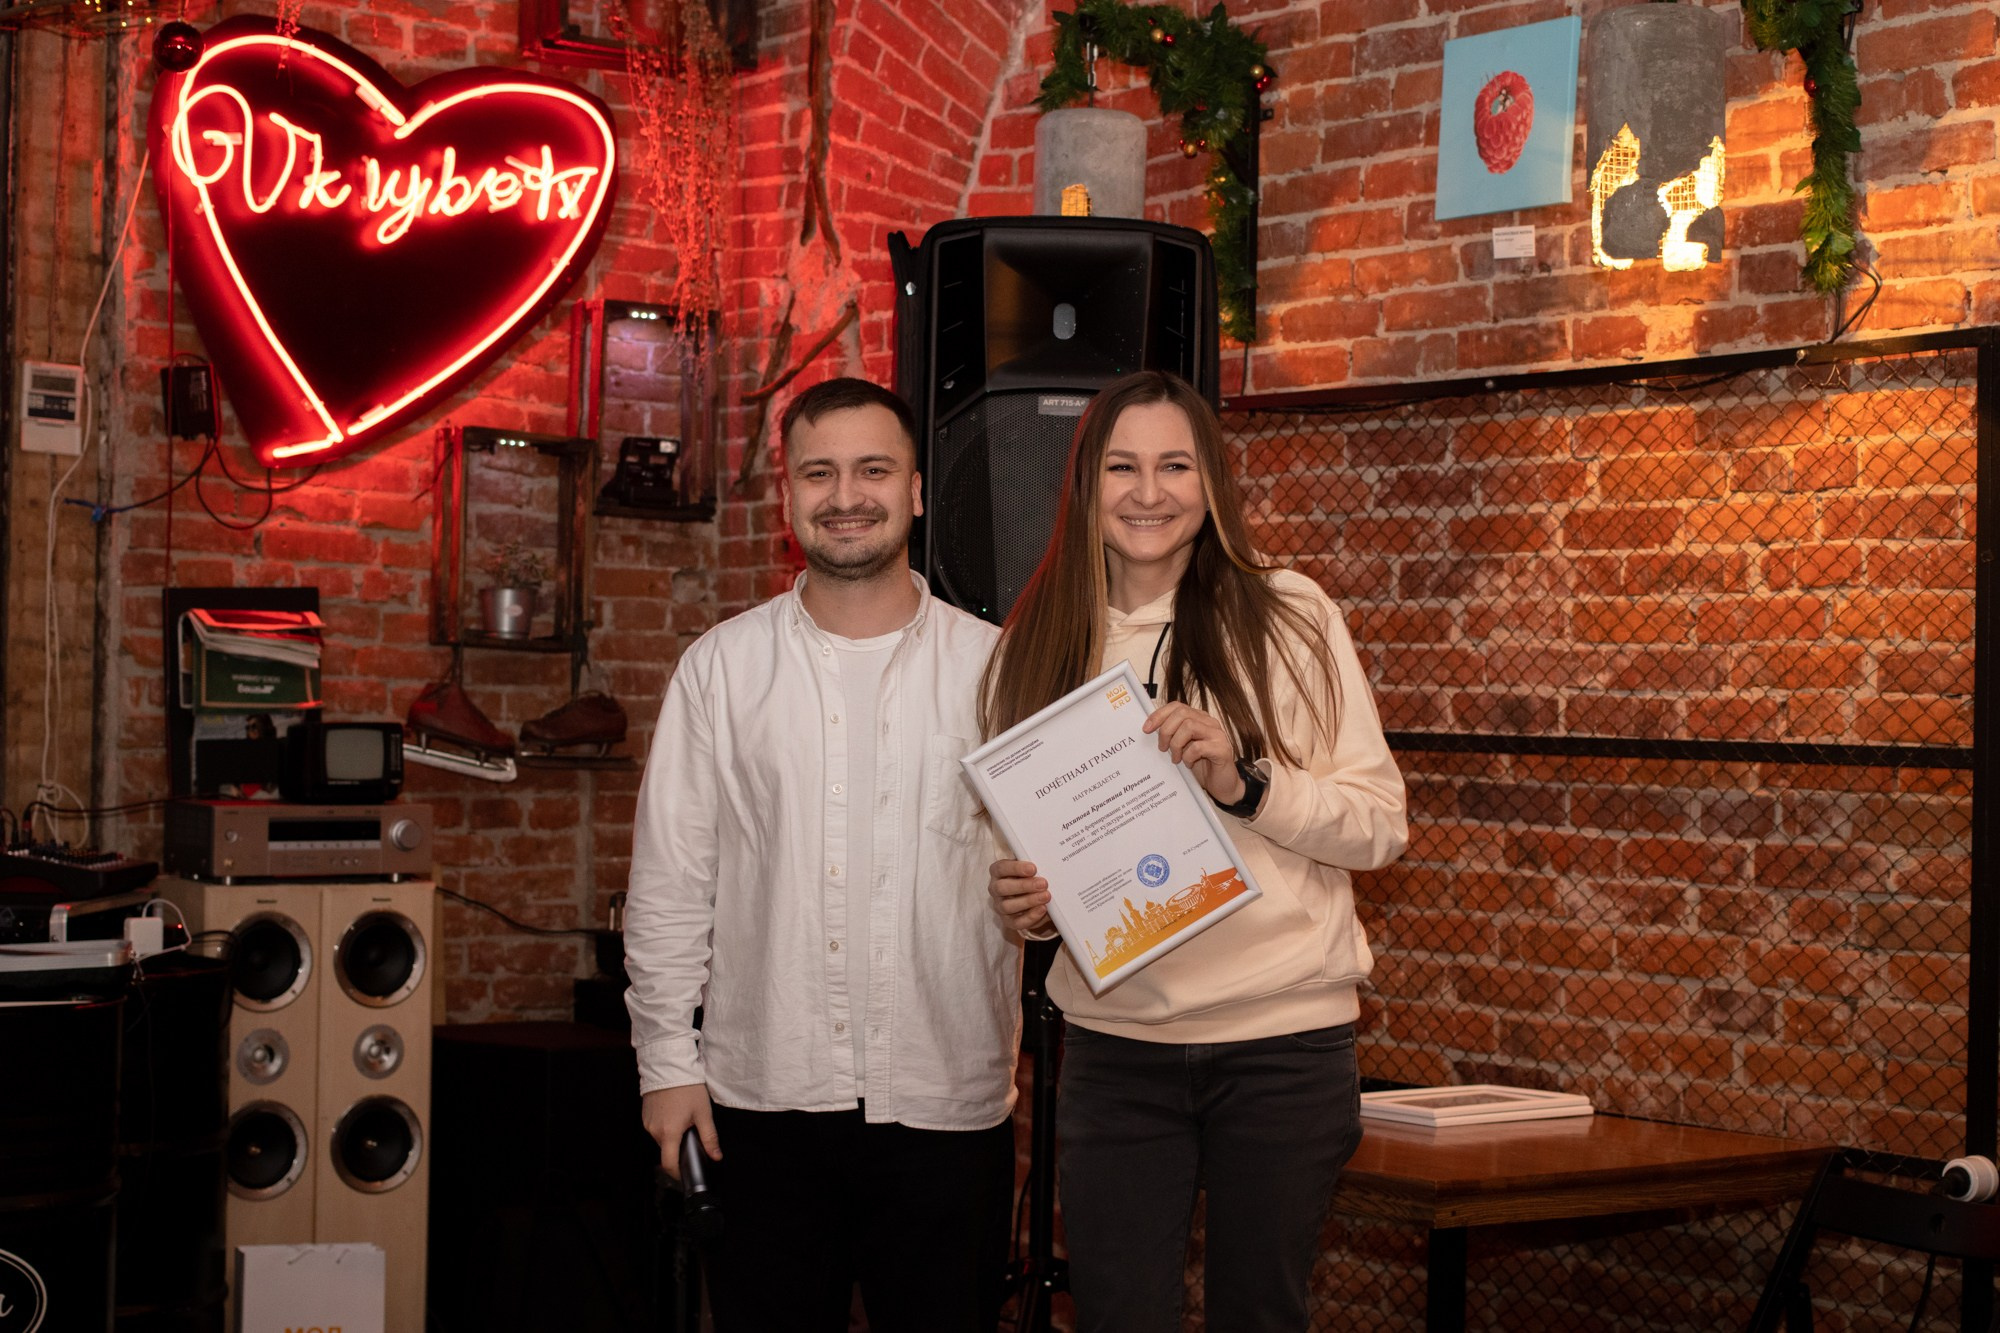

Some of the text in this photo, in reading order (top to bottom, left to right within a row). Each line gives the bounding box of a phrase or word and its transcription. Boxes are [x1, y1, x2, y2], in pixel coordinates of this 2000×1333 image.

[1112, 695, 1131, 710] KRD
[1035, 736, 1135, 799] ПОЧЁТНАЯ ГРАМОТА
[1072, 770, 1121, 802] НАГРАЖДАЕТСЯ
[1061, 790, 1178, 862] муниципального образования город Краснодар
[1062, 774, 1151, 831] Архипова Кристина Юрьевна
[1065, 831, 1081, 842] вклад
[1084, 806, 1121, 831] формирование
[1125, 780, 1165, 806] популяризацию
[1099, 814, 1124, 831] культуры
[1131, 792, 1161, 812] территории
